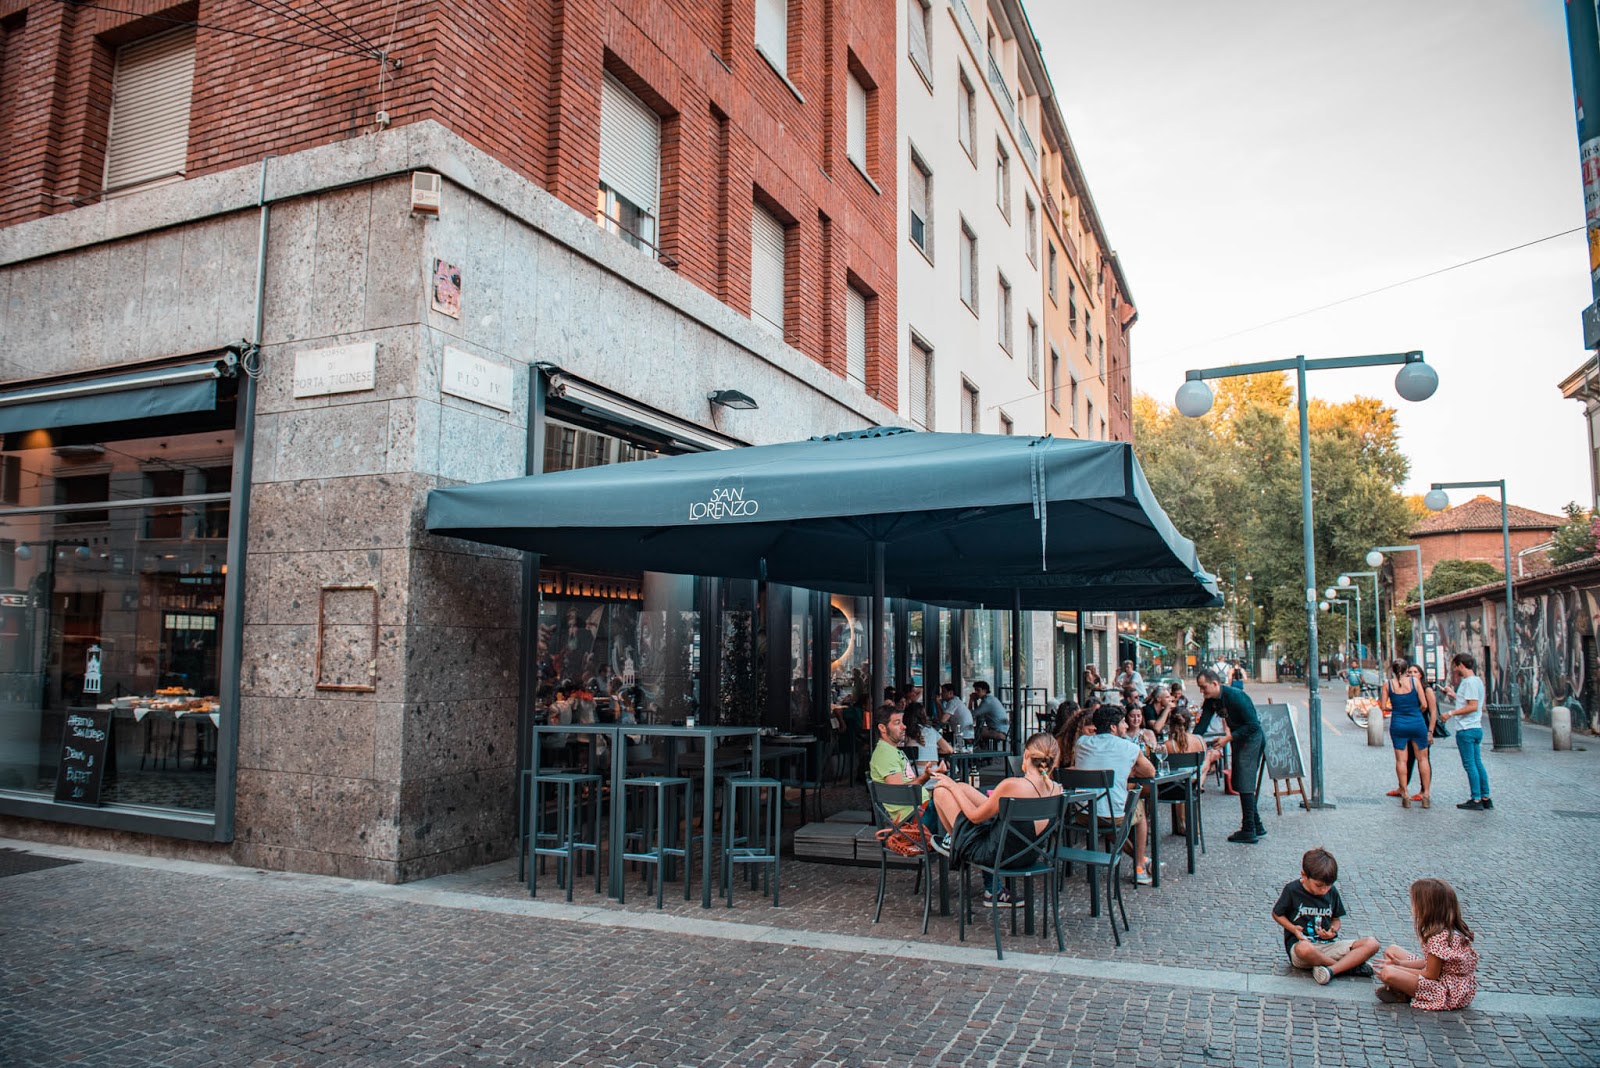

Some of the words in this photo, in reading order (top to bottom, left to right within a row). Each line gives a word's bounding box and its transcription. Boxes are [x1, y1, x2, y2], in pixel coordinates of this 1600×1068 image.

[320, 348, 346, 358] CORSO
[294, 376, 325, 389] PORTA
[328, 371, 373, 386] TICINESE
[457, 371, 480, 388] PIO
[490, 381, 501, 394] IV
[710, 487, 744, 502] SAN
[689, 500, 759, 520] LORENZO
